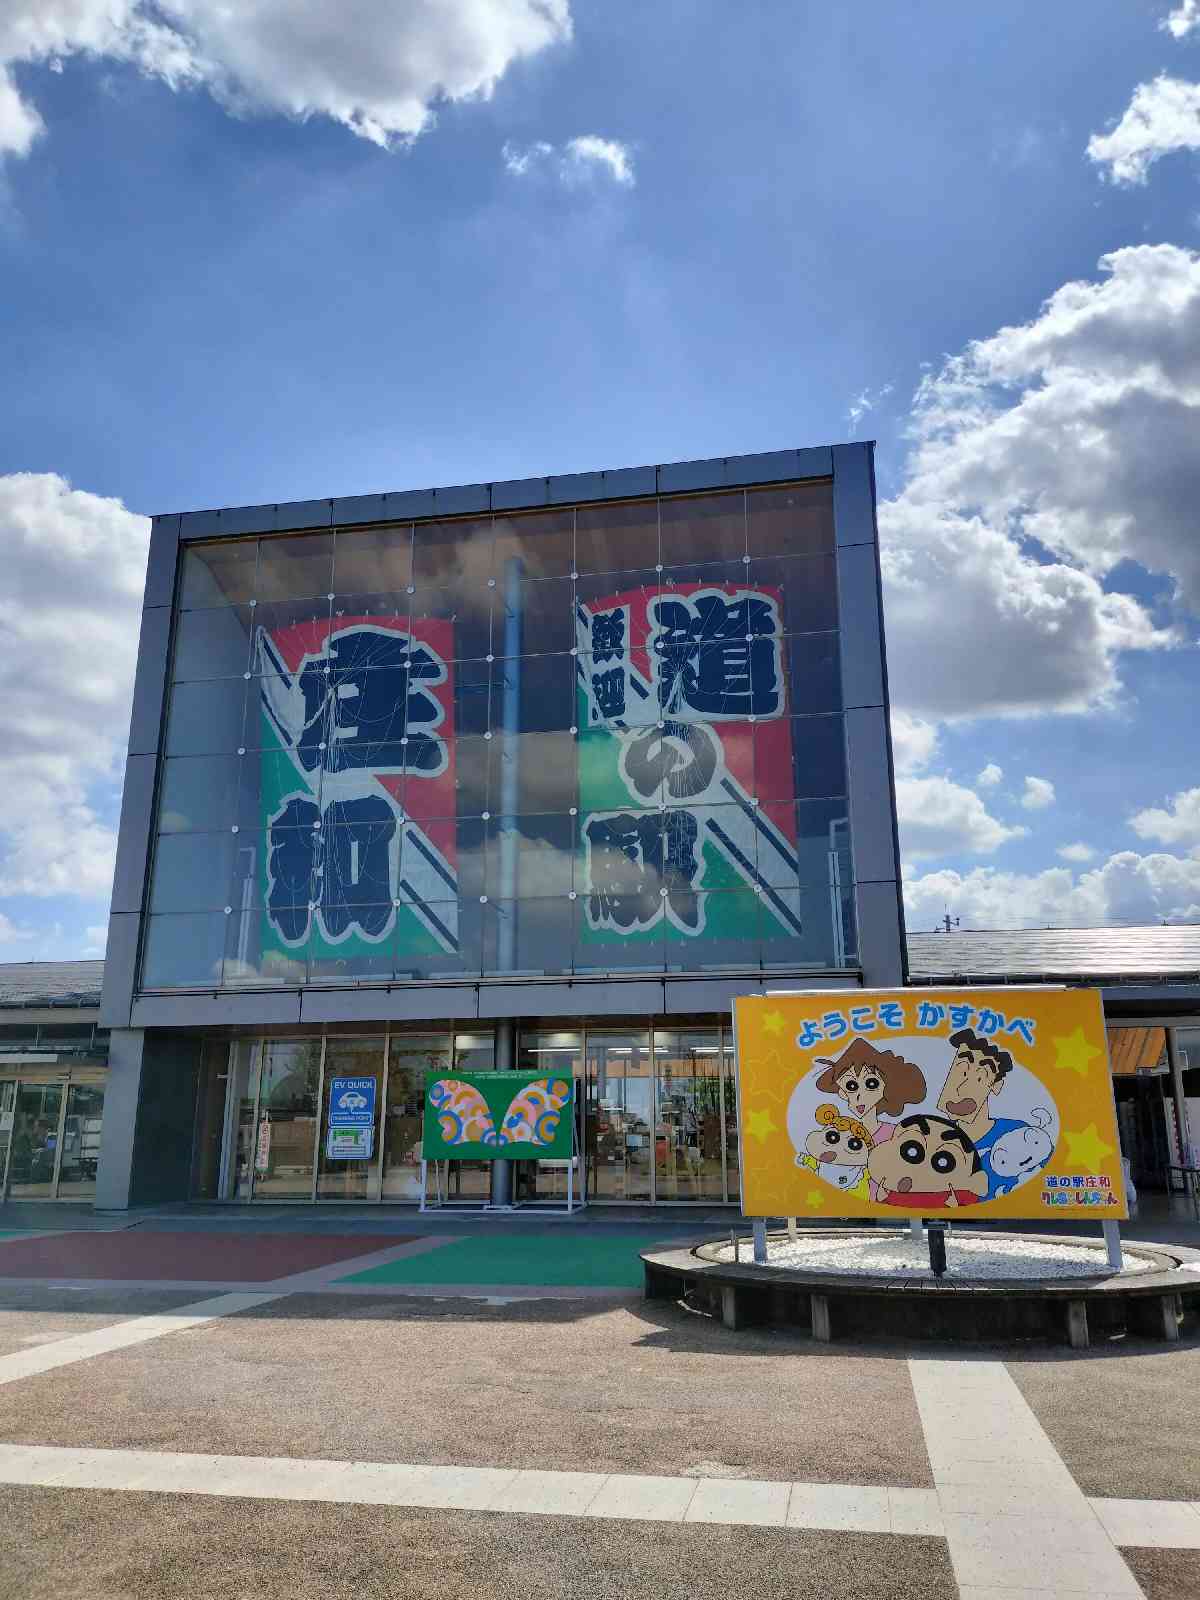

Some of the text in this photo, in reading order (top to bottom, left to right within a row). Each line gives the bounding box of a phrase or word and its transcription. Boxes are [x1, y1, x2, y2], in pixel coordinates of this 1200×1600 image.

[799, 1002, 1035, 1048] ようこそ かすかべ
[334, 1081, 374, 1089] EV QUICK
[1046, 1175, 1111, 1189] 道の駅庄和
